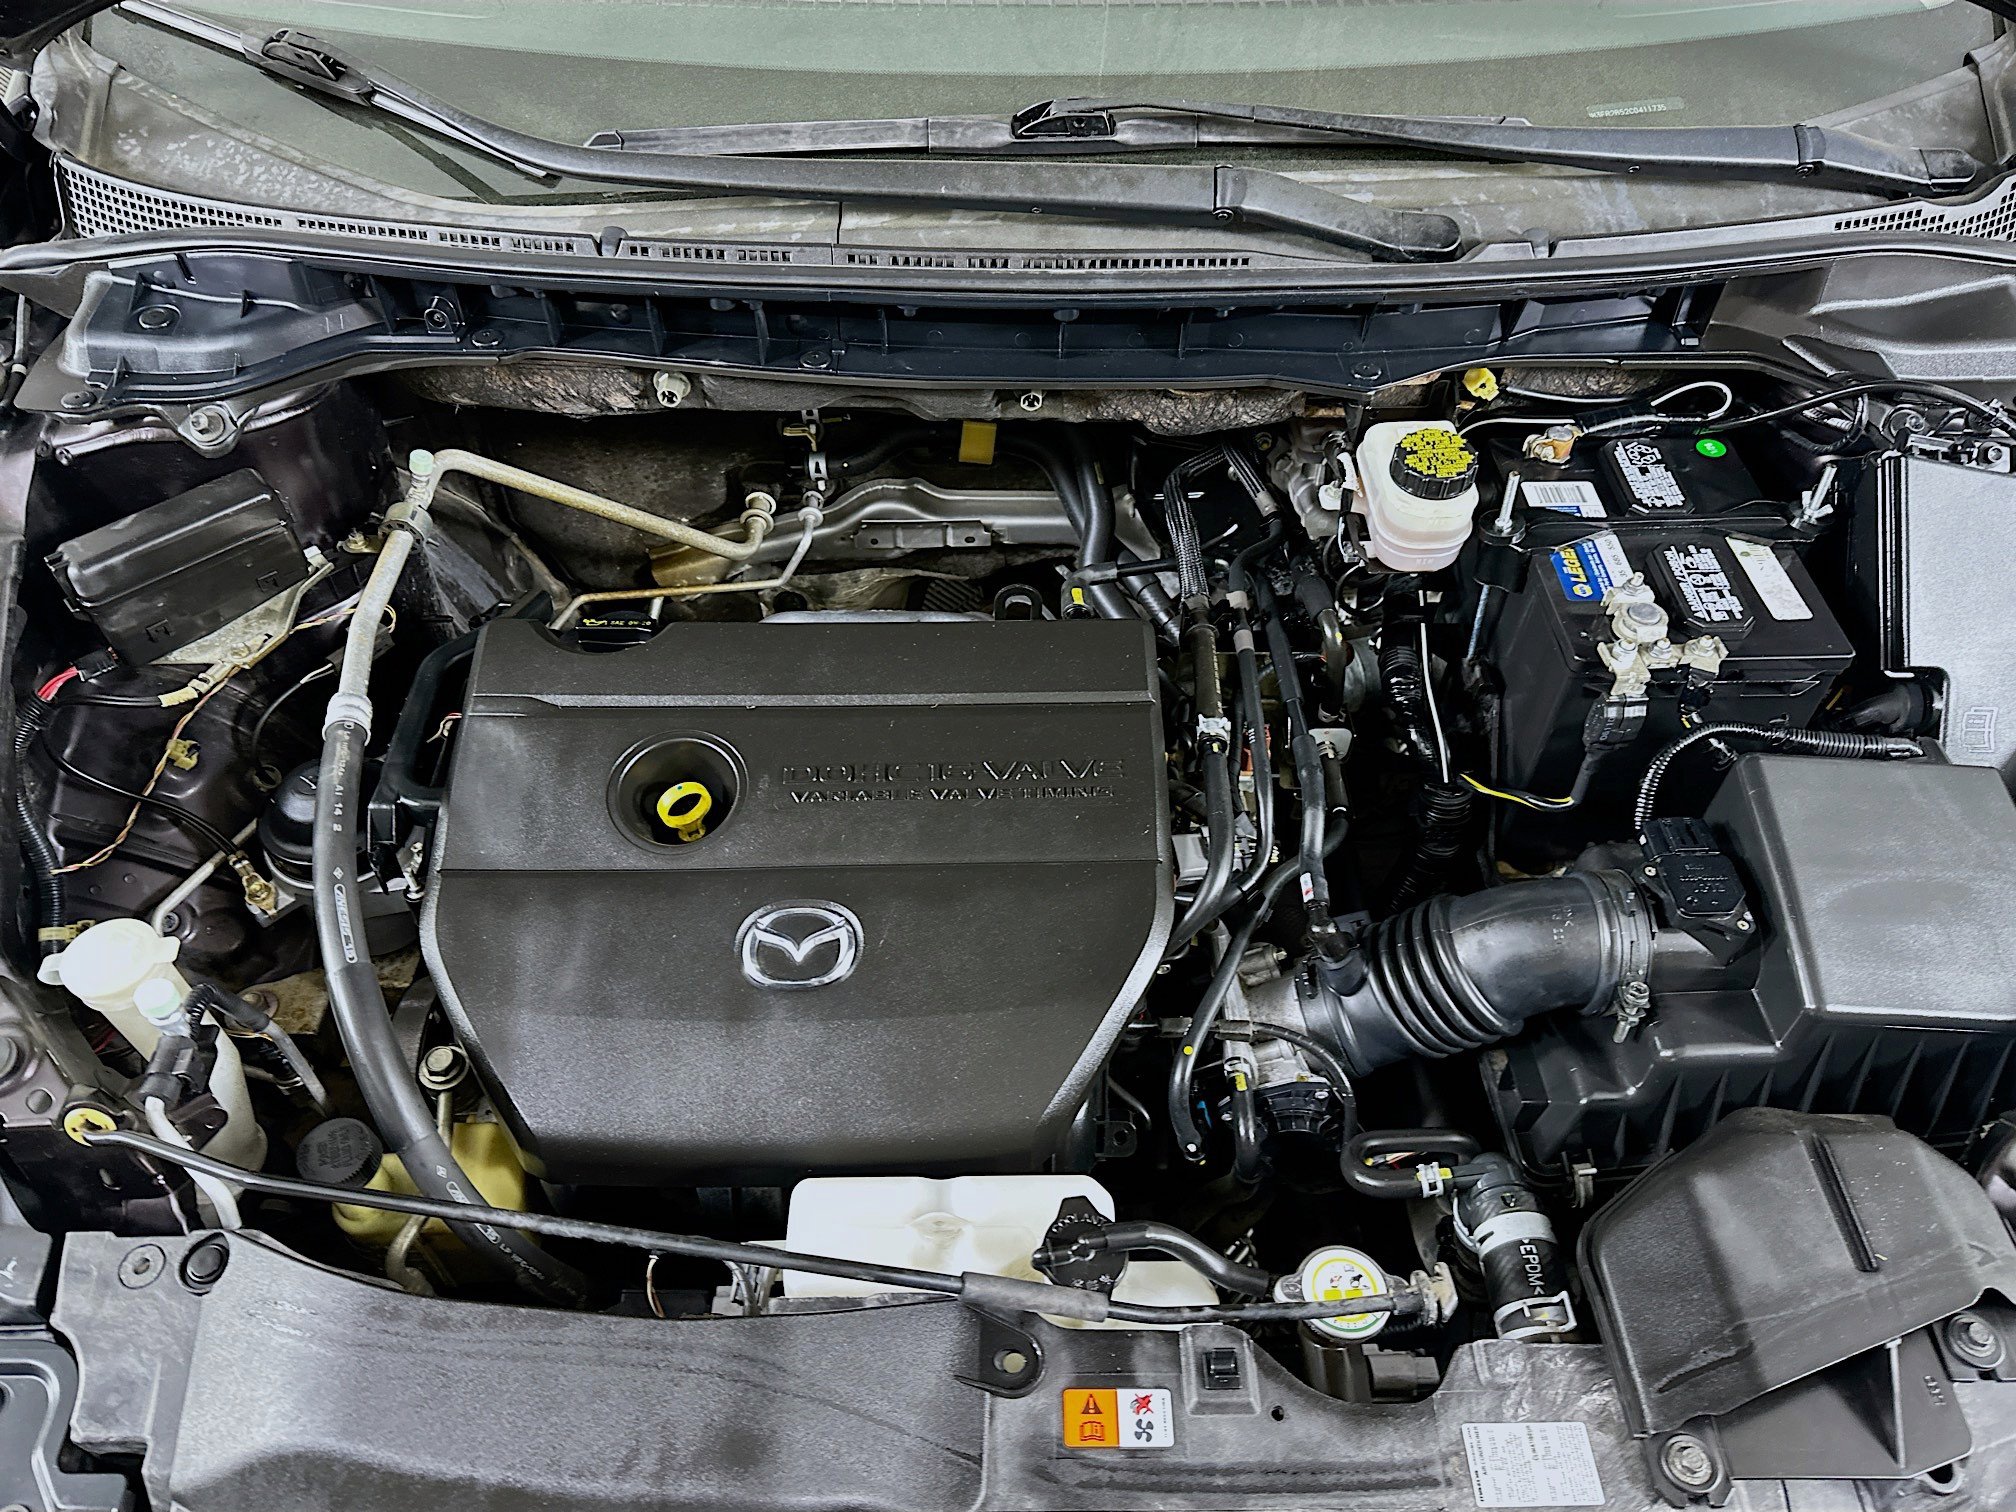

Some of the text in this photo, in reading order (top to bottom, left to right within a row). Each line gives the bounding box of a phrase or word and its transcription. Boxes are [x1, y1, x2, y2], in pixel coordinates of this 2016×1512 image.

[783, 763, 920, 784] DOHC
[790, 789, 924, 803] VARIABLE
[929, 787, 1014, 800] VALVE
